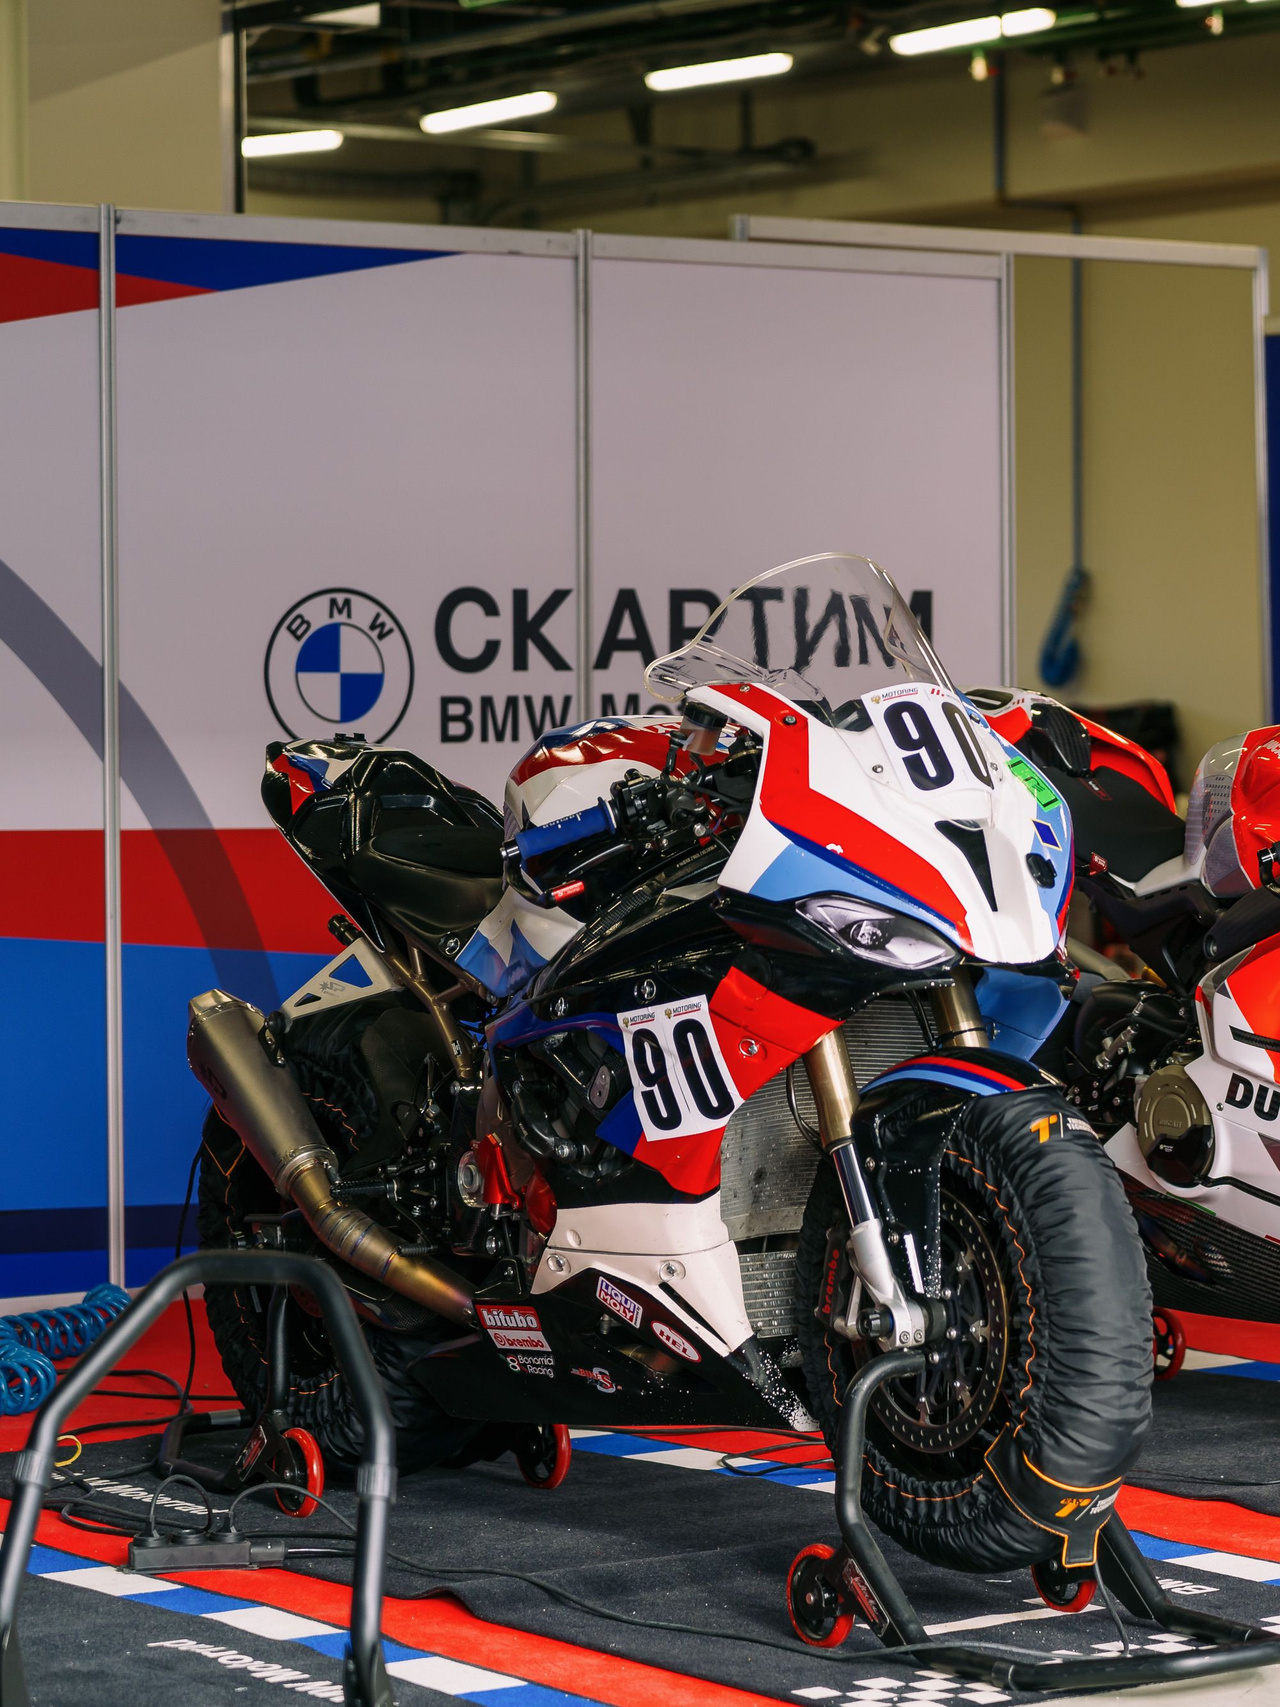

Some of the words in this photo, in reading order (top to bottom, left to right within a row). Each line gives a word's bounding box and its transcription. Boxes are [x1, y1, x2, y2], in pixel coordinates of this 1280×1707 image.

[286, 597, 395, 643] BMW
[881, 686, 919, 699] MOTORING
[883, 700, 994, 791] 90
[629, 1011, 656, 1025] MOTORING
[672, 1001, 702, 1016] MOTORING
[631, 1018, 736, 1132] 90
[822, 1248, 839, 1314] brembo
[600, 1280, 636, 1311] LIQUI
[600, 1291, 634, 1322] MOLY
[482, 1309, 538, 1328] bitubo
[504, 1335, 545, 1348] brembo
[659, 1330, 691, 1357] HEL
[527, 1365, 555, 1378] Racing
